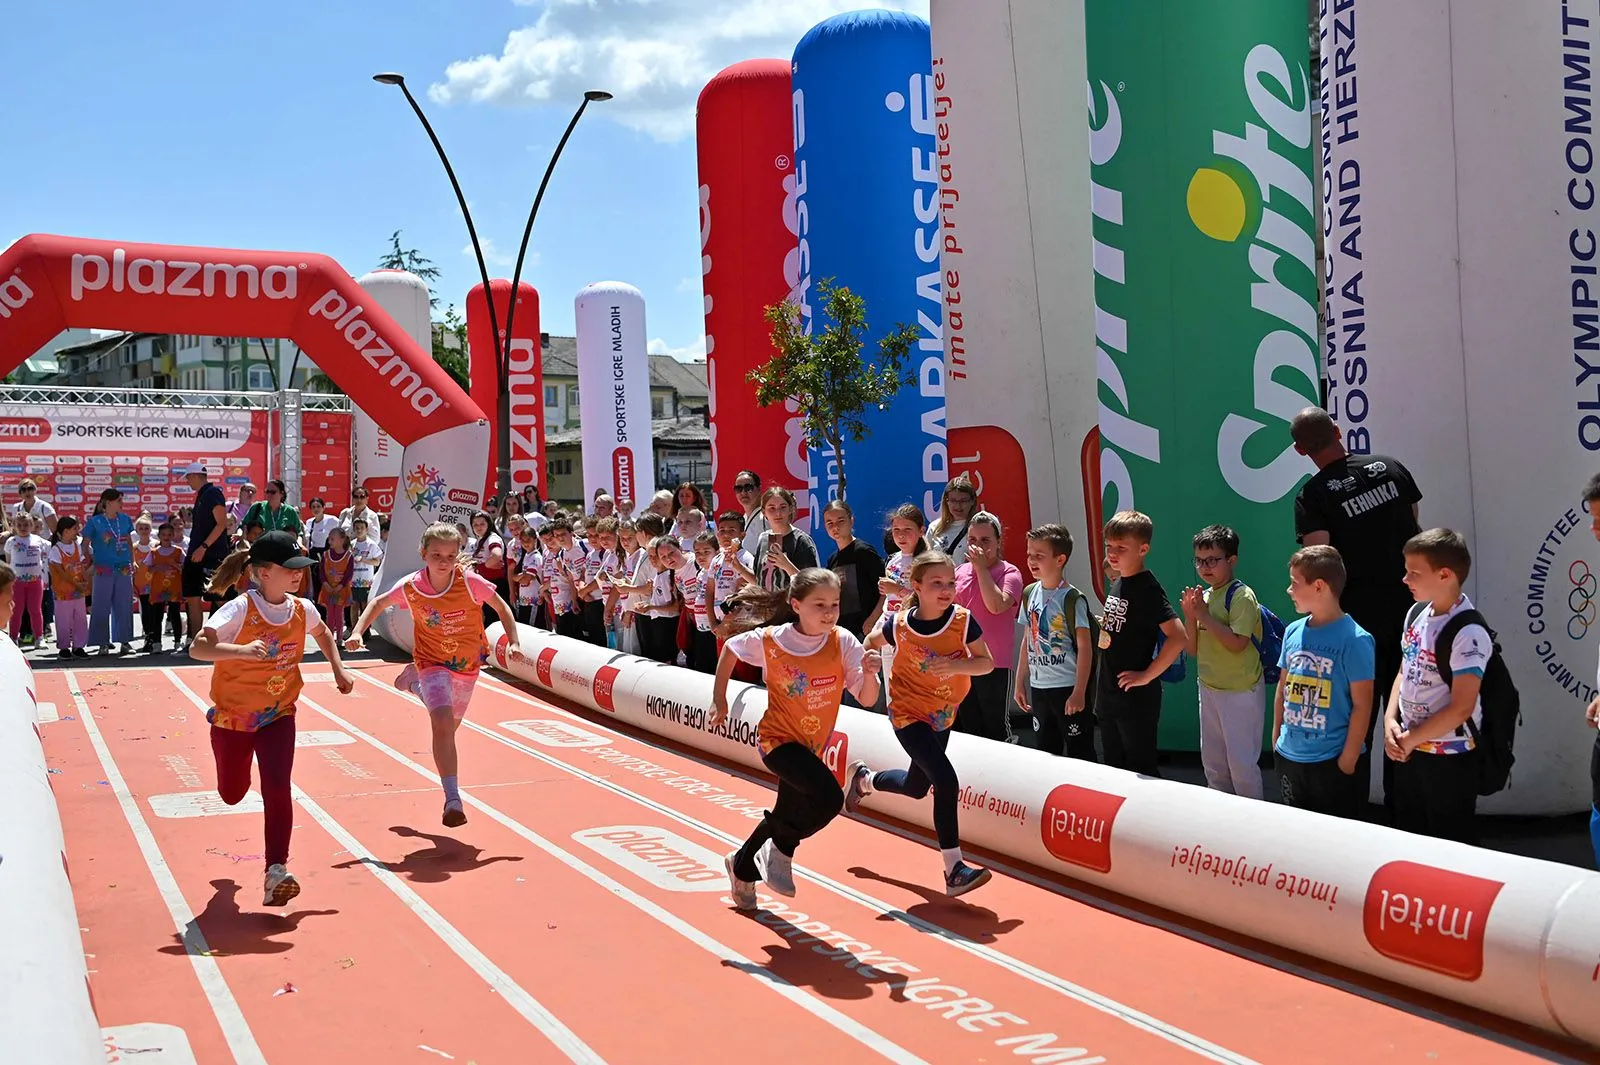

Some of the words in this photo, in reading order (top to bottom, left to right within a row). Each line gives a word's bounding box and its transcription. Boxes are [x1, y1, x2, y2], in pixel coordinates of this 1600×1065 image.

[1562, 0, 1596, 211] COMMIT
[932, 56, 963, 255] prijatelje!
[1337, 159, 1363, 260] AND
[70, 248, 298, 300] plazma
[1217, 43, 1318, 504] Sprite
[610, 305, 622, 352] MLADIH
[945, 270, 968, 381] imate
[1324, 253, 1338, 421] LYMPIC
[1569, 227, 1600, 452] OLYMPIC
[308, 288, 445, 418] plazma
[612, 355, 624, 382] IGRE
[1340, 270, 1371, 455] BOSNIA
[57, 425, 132, 438] SPORTSKE
[137, 426, 169, 439] IGRE
[173, 427, 230, 439] MLADIH
[508, 338, 538, 491] azma
[612, 384, 627, 443] SPORTSKE
[374, 427, 389, 457] ima
[616, 455, 630, 500] lazma
[822, 434, 846, 503] ank
[438, 514, 458, 524] IGRE
[440, 504, 471, 517] SPORTS
[451, 491, 477, 502] plazma
[1341, 480, 1400, 519] TEHNIKA
[1527, 508, 1580, 635] COMMITTEE
[1050, 652, 1067, 666] DAY
[645, 694, 682, 724] MLADIH
[683, 704, 707, 732] IGRE
[700, 790, 771, 820] MLAD
[988, 796, 1027, 826] imate
[1050, 807, 1105, 843] m:tel
[584, 830, 727, 883] plazma
[1171, 845, 1273, 889] prijatelje!
[1275, 872, 1339, 911] imate
[1379, 889, 1473, 940] m:tel
